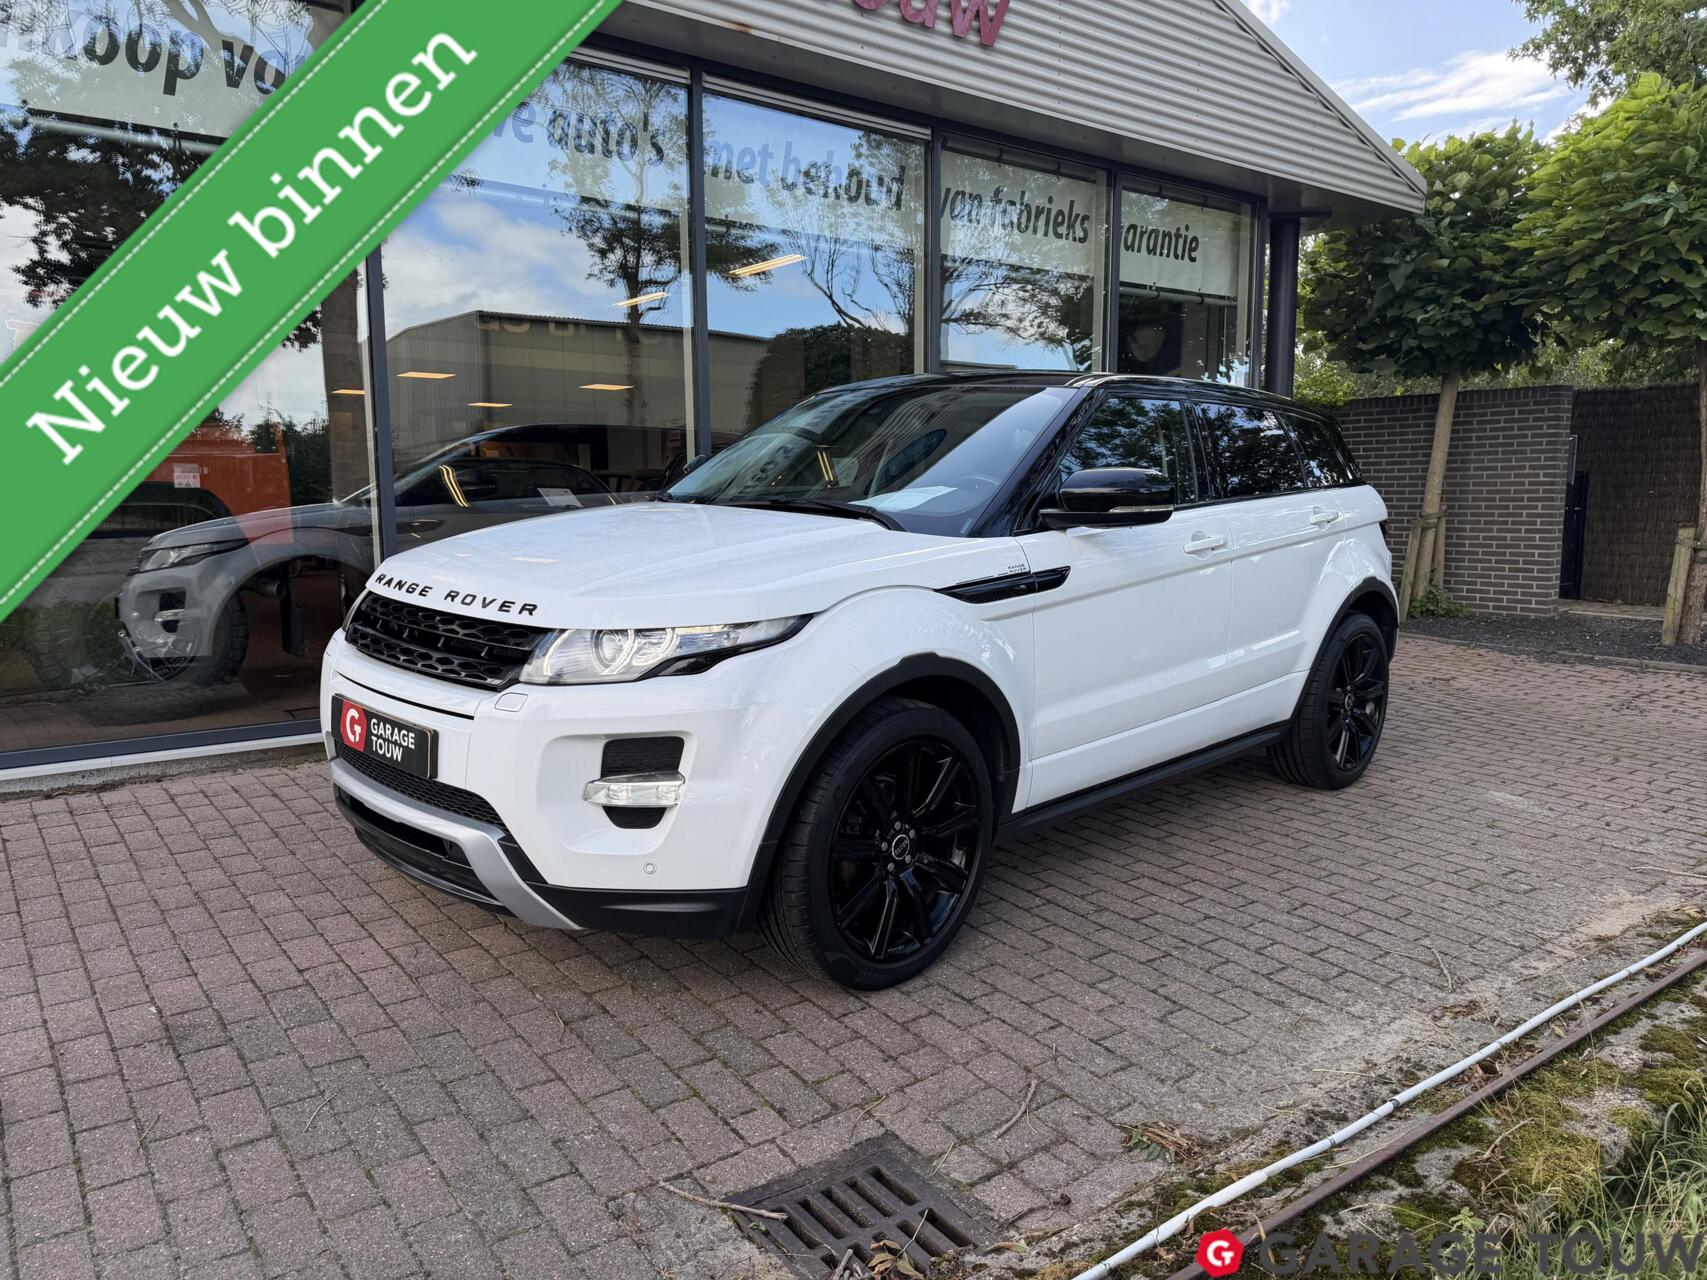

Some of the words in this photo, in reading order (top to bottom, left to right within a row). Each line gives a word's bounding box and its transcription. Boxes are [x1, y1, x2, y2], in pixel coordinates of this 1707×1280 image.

[854, 0, 1010, 47] uw
[546, 108, 666, 168] auto's
[703, 139, 774, 187] met
[780, 140, 907, 212] behoud
[989, 184, 1090, 244] fabrieks
[1121, 223, 1201, 264] arantie
[375, 573, 433, 597] RANGE
[443, 590, 539, 617] ROVER
[370, 718, 416, 750] GARAGE
[371, 735, 403, 762] TOUW
